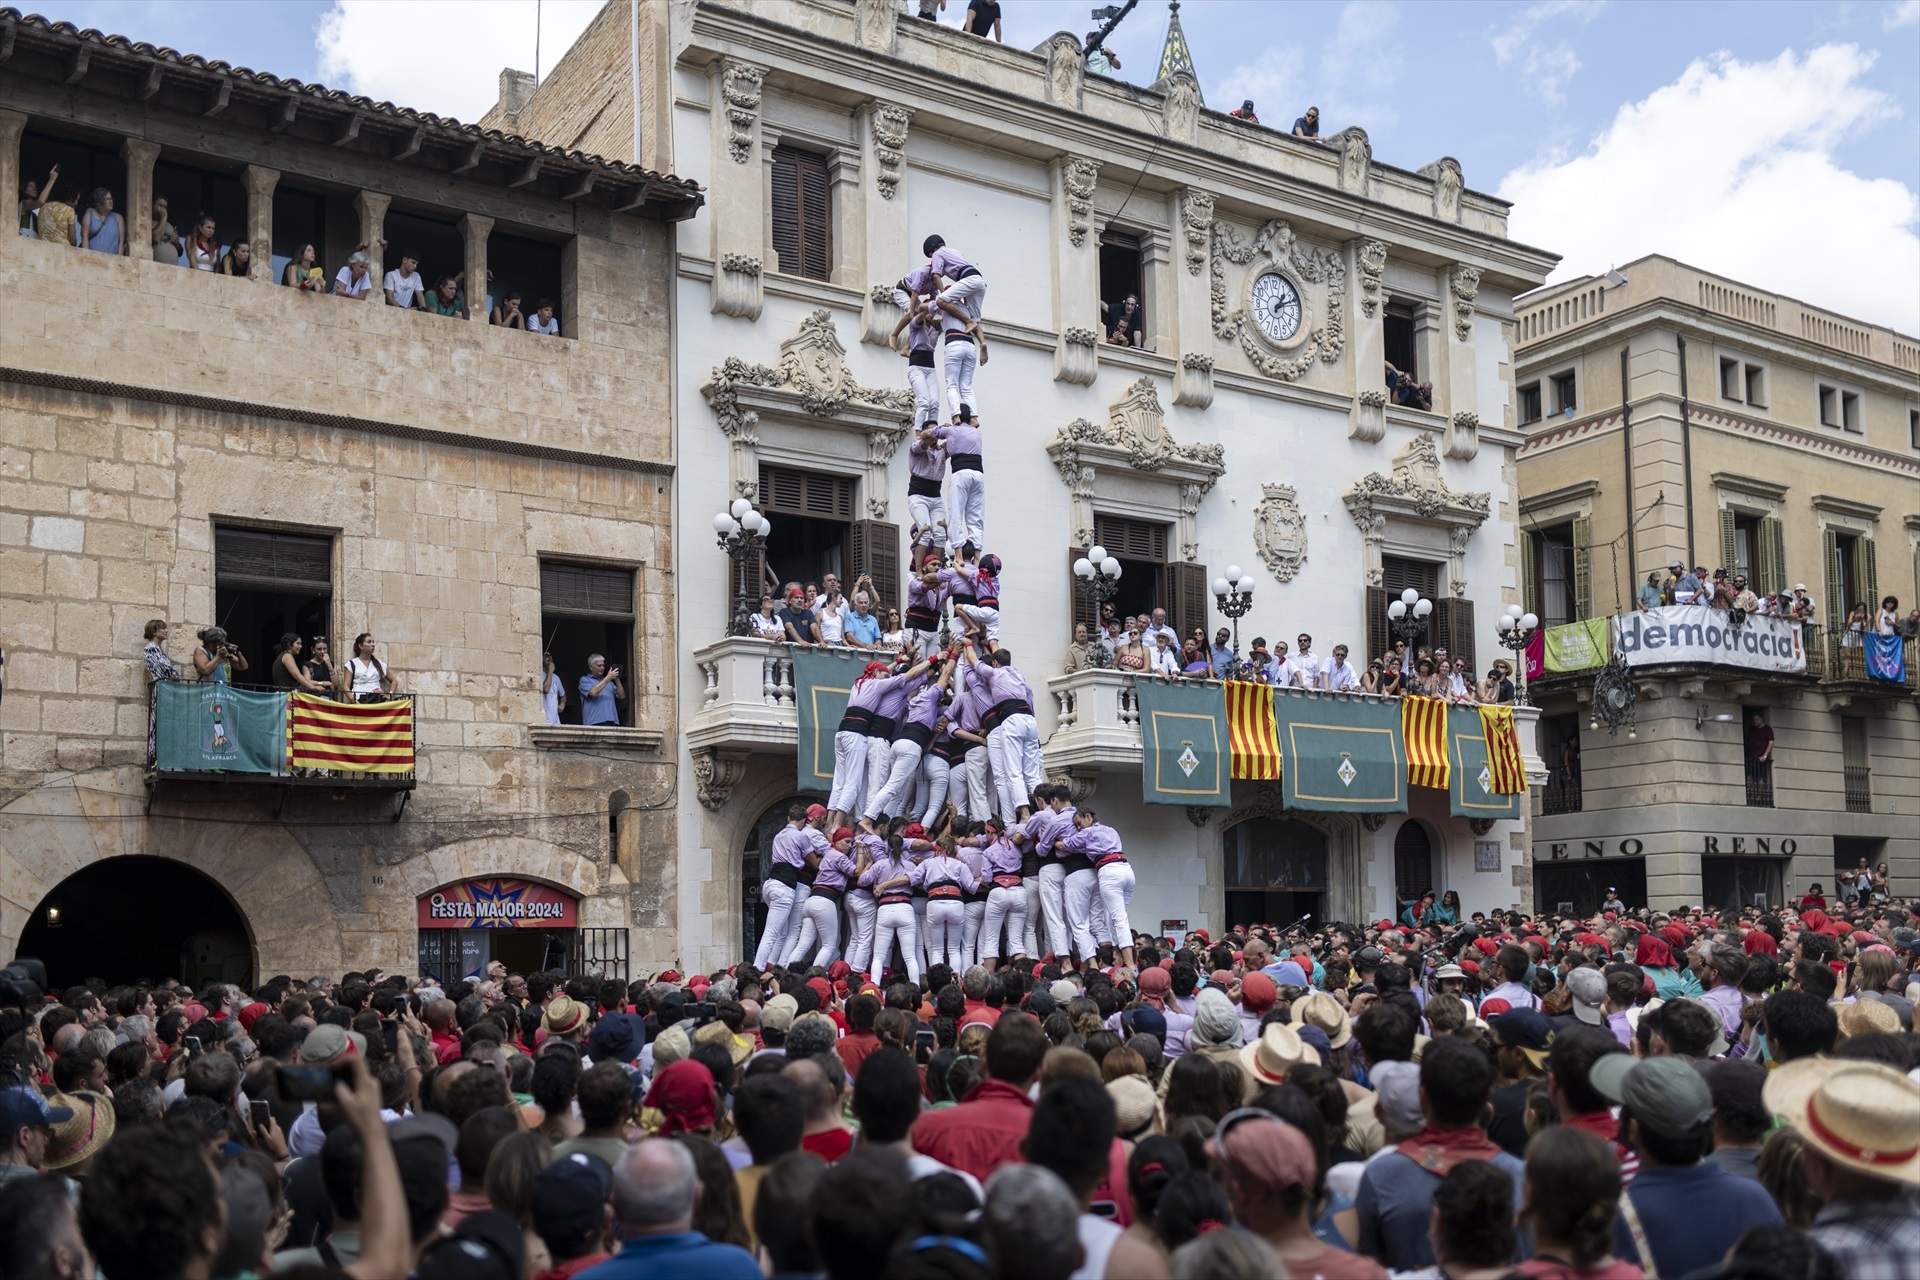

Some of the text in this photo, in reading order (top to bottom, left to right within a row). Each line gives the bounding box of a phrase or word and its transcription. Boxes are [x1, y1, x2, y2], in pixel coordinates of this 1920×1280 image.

[1272, 280, 1278, 290] 12
[1258, 288, 1264, 296] 10
[1532, 838, 1644, 860] ENO
[1704, 836, 1797, 856] RENO
[372, 875, 384, 885] 16
[431, 901, 563, 918] FESTA MAJOR 2024!
